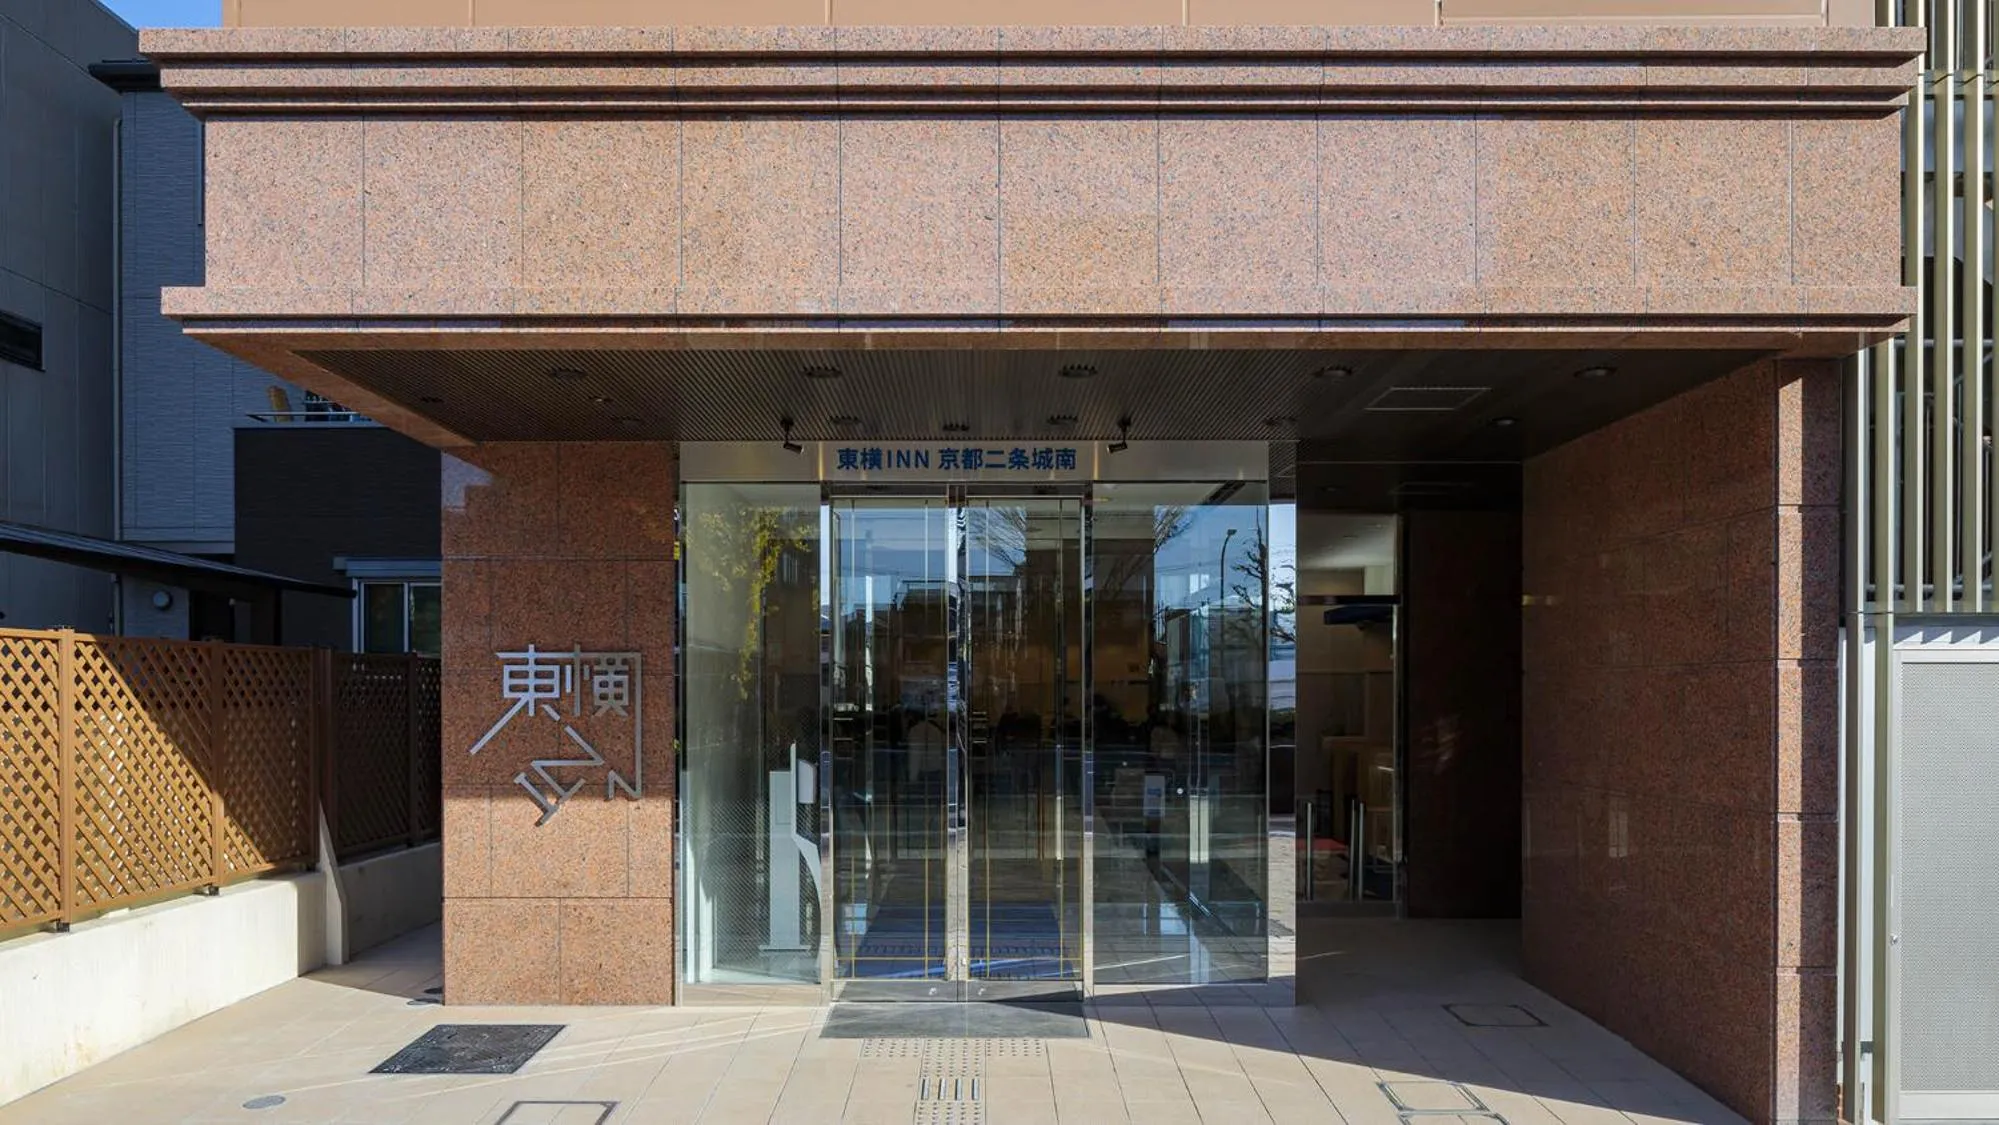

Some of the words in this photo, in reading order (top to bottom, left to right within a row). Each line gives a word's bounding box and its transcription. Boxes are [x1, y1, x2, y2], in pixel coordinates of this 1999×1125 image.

[837, 447, 930, 470] 東横INN
[938, 447, 1077, 470] 京都二条城南
